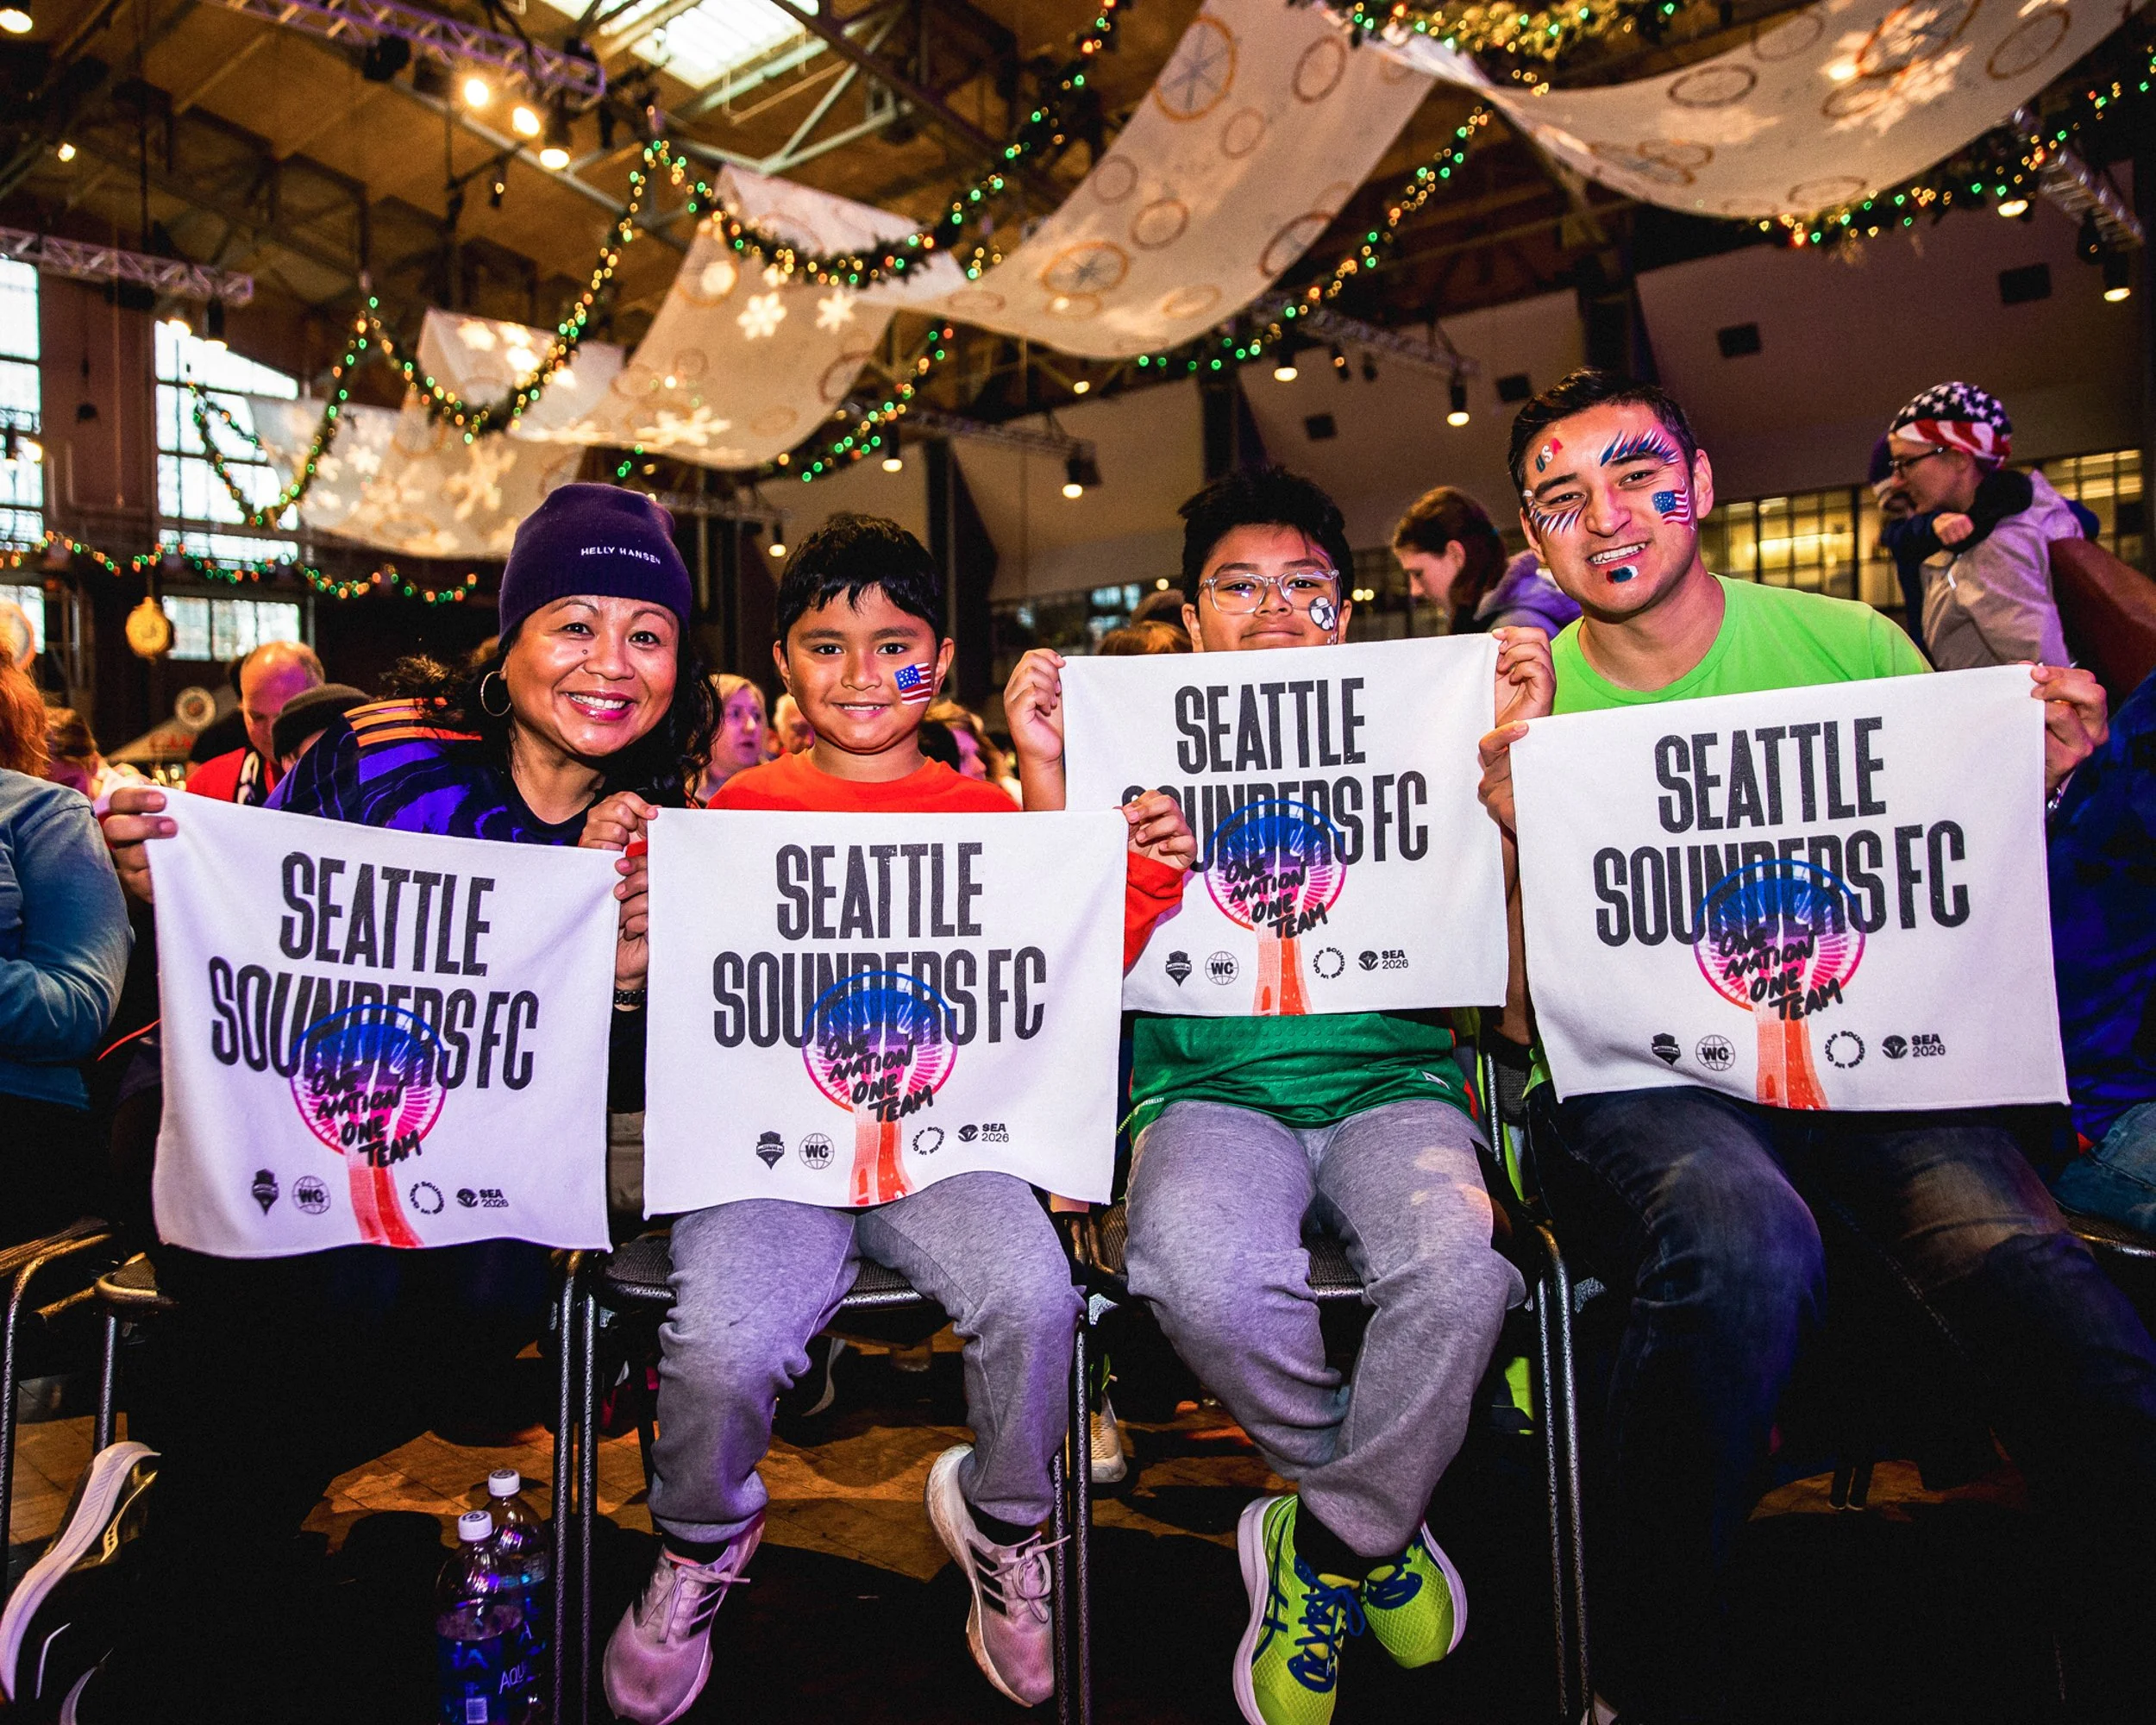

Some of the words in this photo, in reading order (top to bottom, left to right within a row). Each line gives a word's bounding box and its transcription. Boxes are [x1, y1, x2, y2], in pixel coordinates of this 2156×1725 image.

[1536, 437, 1564, 473] USA
[581, 547, 615, 556] HELLY
[619, 548, 661, 564] HANSEN
[1175, 678, 1366, 775] SEATTLE
[1654, 717, 1886, 833] SEATTLE
[1122, 776, 1363, 872] UNDERS
[1373, 770, 1428, 862] FC
[1225, 856, 1265, 883] ONE
[1229, 861, 1307, 904] NATION
[1593, 830, 1887, 947] SOUNDERS
[1895, 820, 1971, 930] FC
[776, 843, 982, 941] SEATTLE
[1251, 893, 1294, 923] ONE
[279, 851, 495, 976] SEATTLE
[1268, 902, 1328, 938] TEAM
[1382, 950, 1406, 959] SEA
[1719, 928, 1767, 957] ONE
[1723, 930, 1815, 980] NATION
[1210, 962, 1234, 975] WC
[1382, 959, 1409, 969] 2026
[712, 949, 977, 1049] SOUNDERS
[987, 946, 1046, 1043] FC
[1750, 967, 1801, 1002] ONE
[1768, 977, 1843, 1020] TEAM
[209, 957, 476, 1090] SOUNDERS
[477, 989, 540, 1090] FC
[1911, 1034, 1941, 1045] SEA
[824, 1032, 869, 1062] ONE
[828, 1039, 915, 1082] NATION
[1702, 1045, 1730, 1061] WC
[1912, 1044, 1946, 1057] 2026
[317, 1078, 407, 1120] NATION
[852, 1074, 898, 1104] ONE
[868, 1084, 933, 1122] TEAM
[341, 1114, 385, 1146] ONE
[981, 1132, 1010, 1143] 2026
[982, 1123, 1006, 1132] SEA
[358, 1130, 422, 1168] TEAM
[805, 1145, 830, 1158] WC
[298, 1188, 325, 1203] WC
[479, 1189, 504, 1199] SEA
